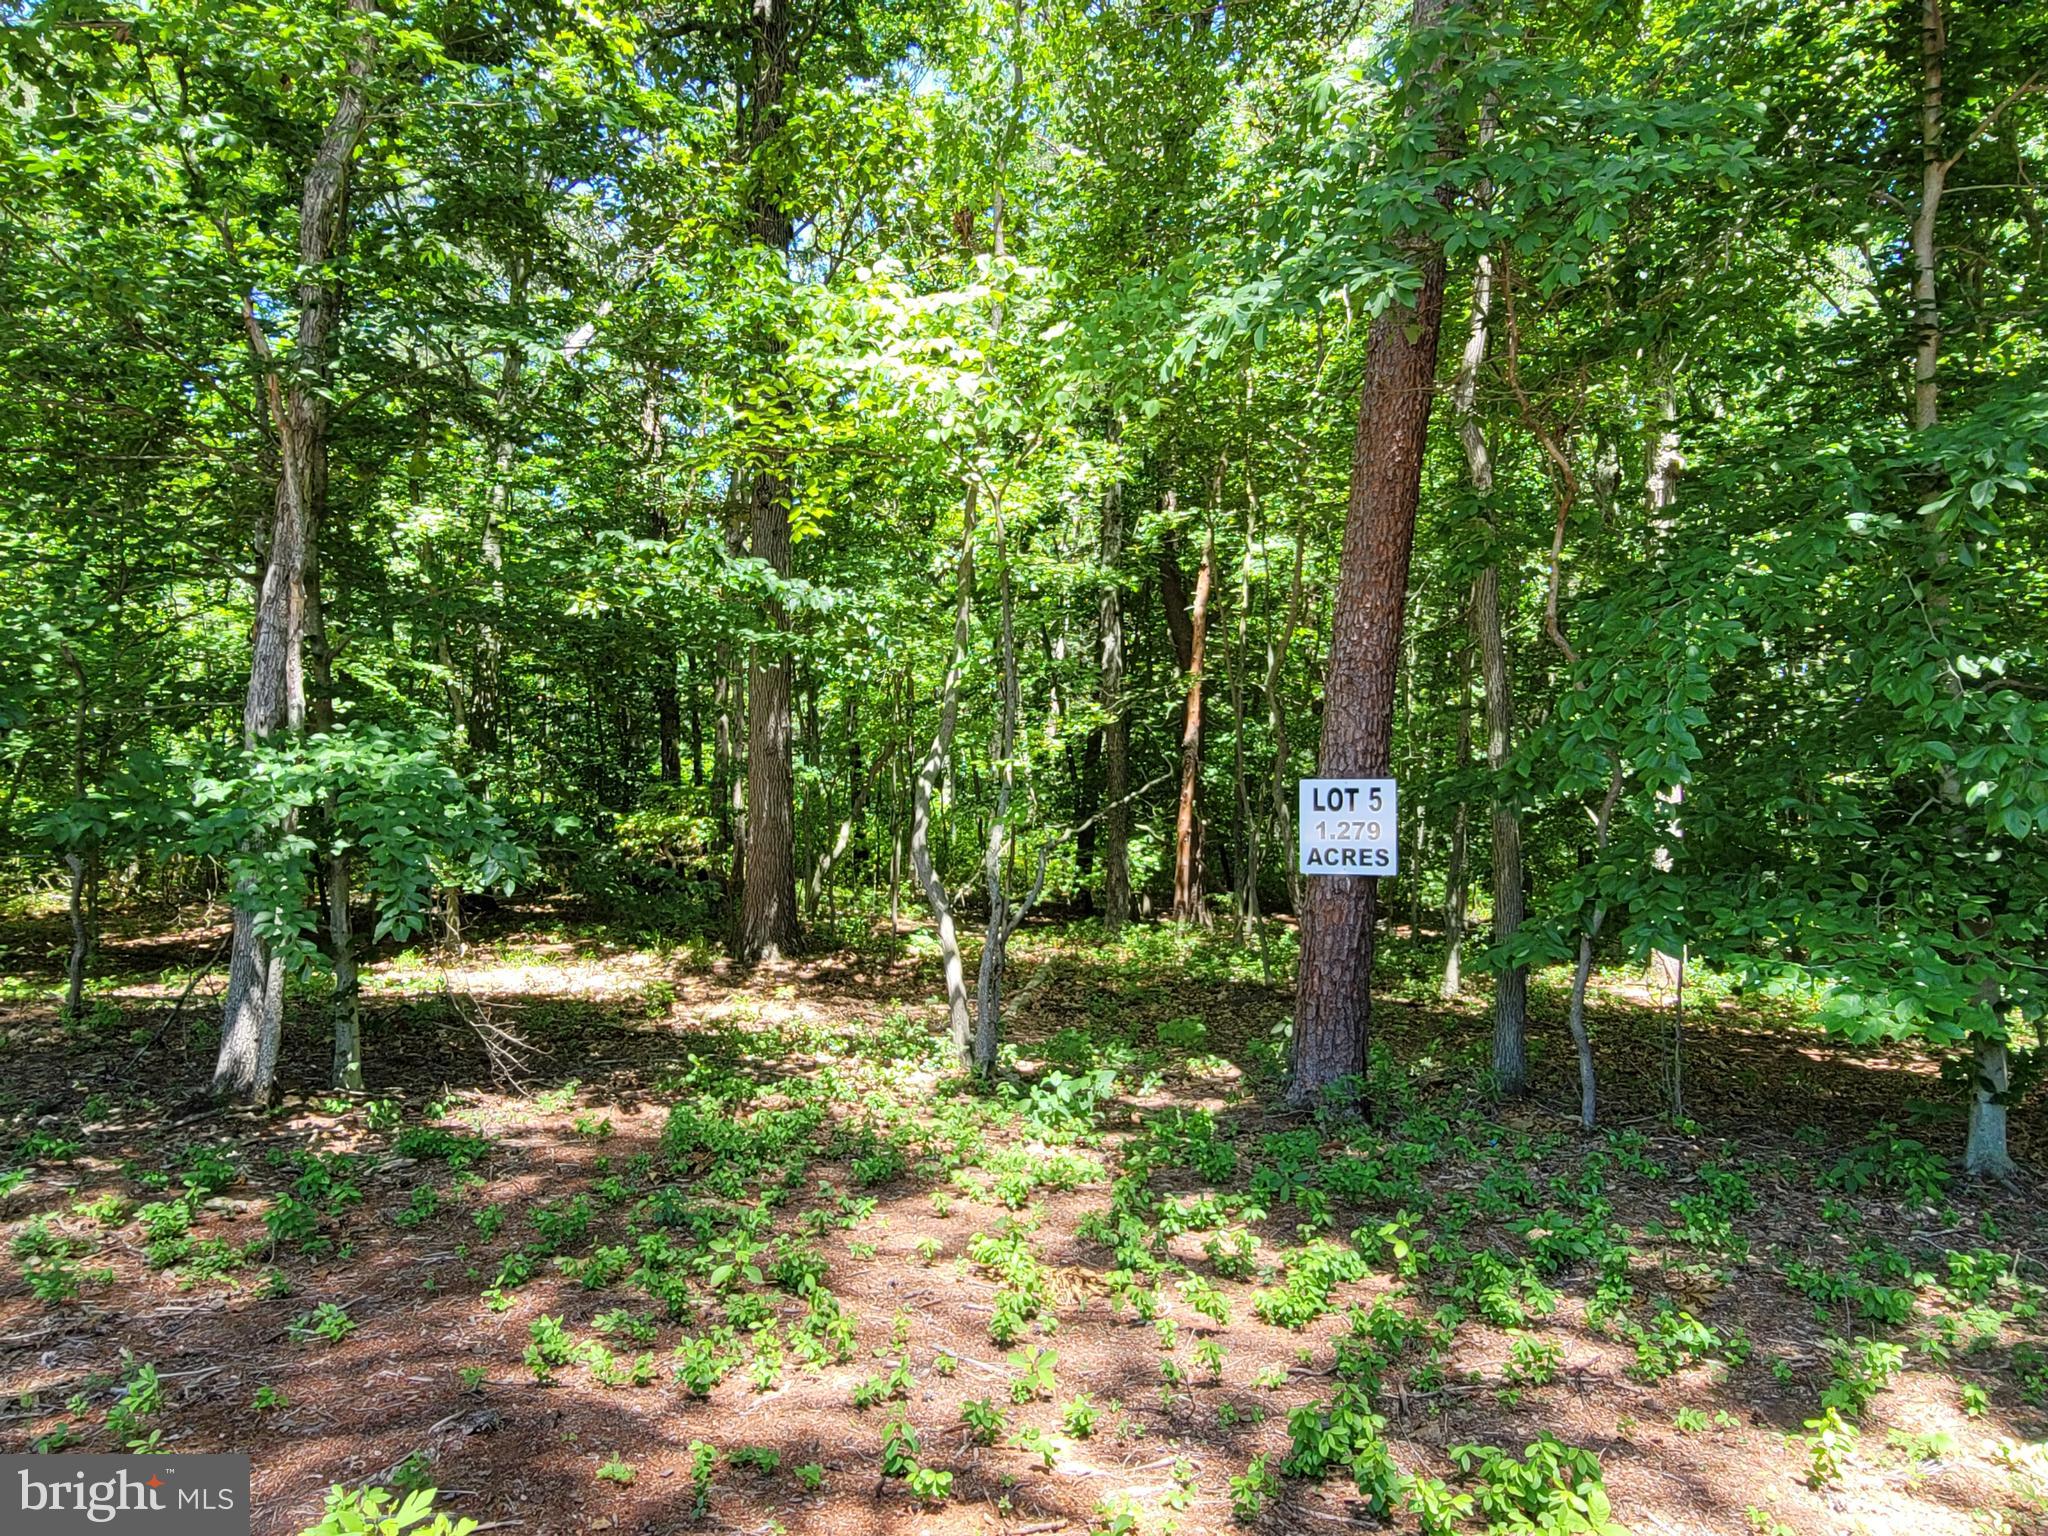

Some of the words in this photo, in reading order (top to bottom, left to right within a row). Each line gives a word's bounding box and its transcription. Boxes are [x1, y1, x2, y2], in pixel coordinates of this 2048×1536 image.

[1313, 787, 1359, 812] LOT
[1368, 787, 1382, 812] 5
[1315, 821, 1381, 840] 1.279
[1306, 847, 1390, 867] ACRES
